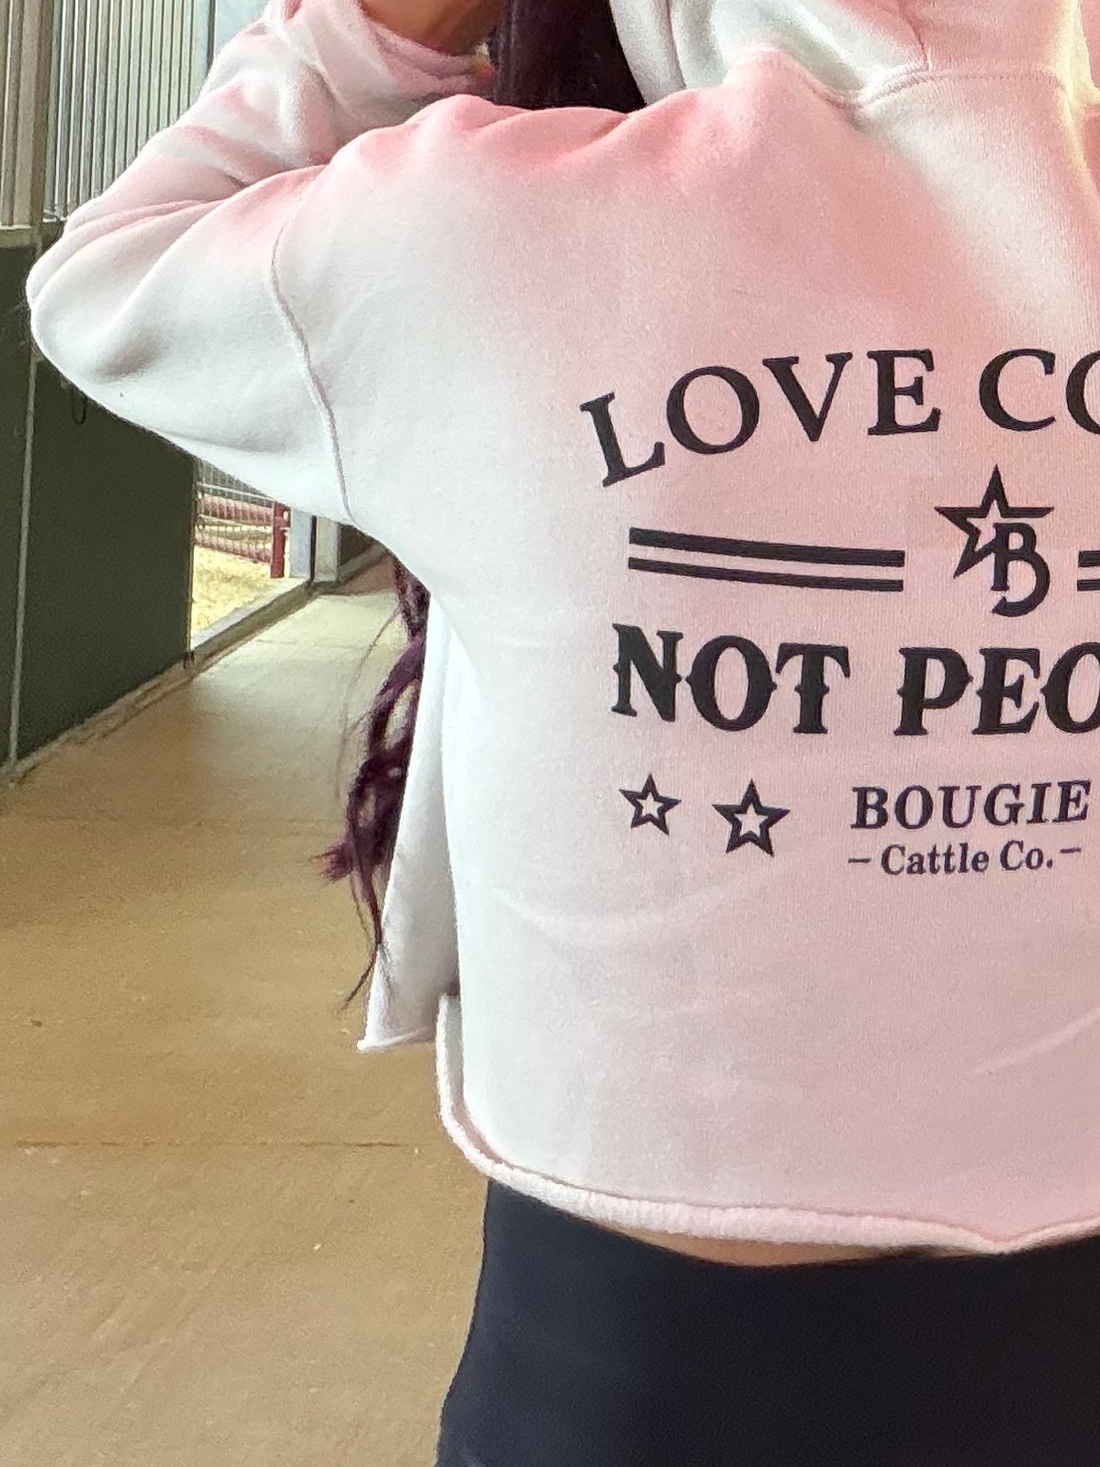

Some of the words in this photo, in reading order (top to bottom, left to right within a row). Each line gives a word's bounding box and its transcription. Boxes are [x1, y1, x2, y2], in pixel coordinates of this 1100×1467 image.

[580, 349, 942, 488] LOVE
[611, 623, 851, 736] NOT
[850, 778, 1092, 830] BOUGIE
[880, 842, 990, 876] Cattle
[999, 839, 1054, 872] Co.
